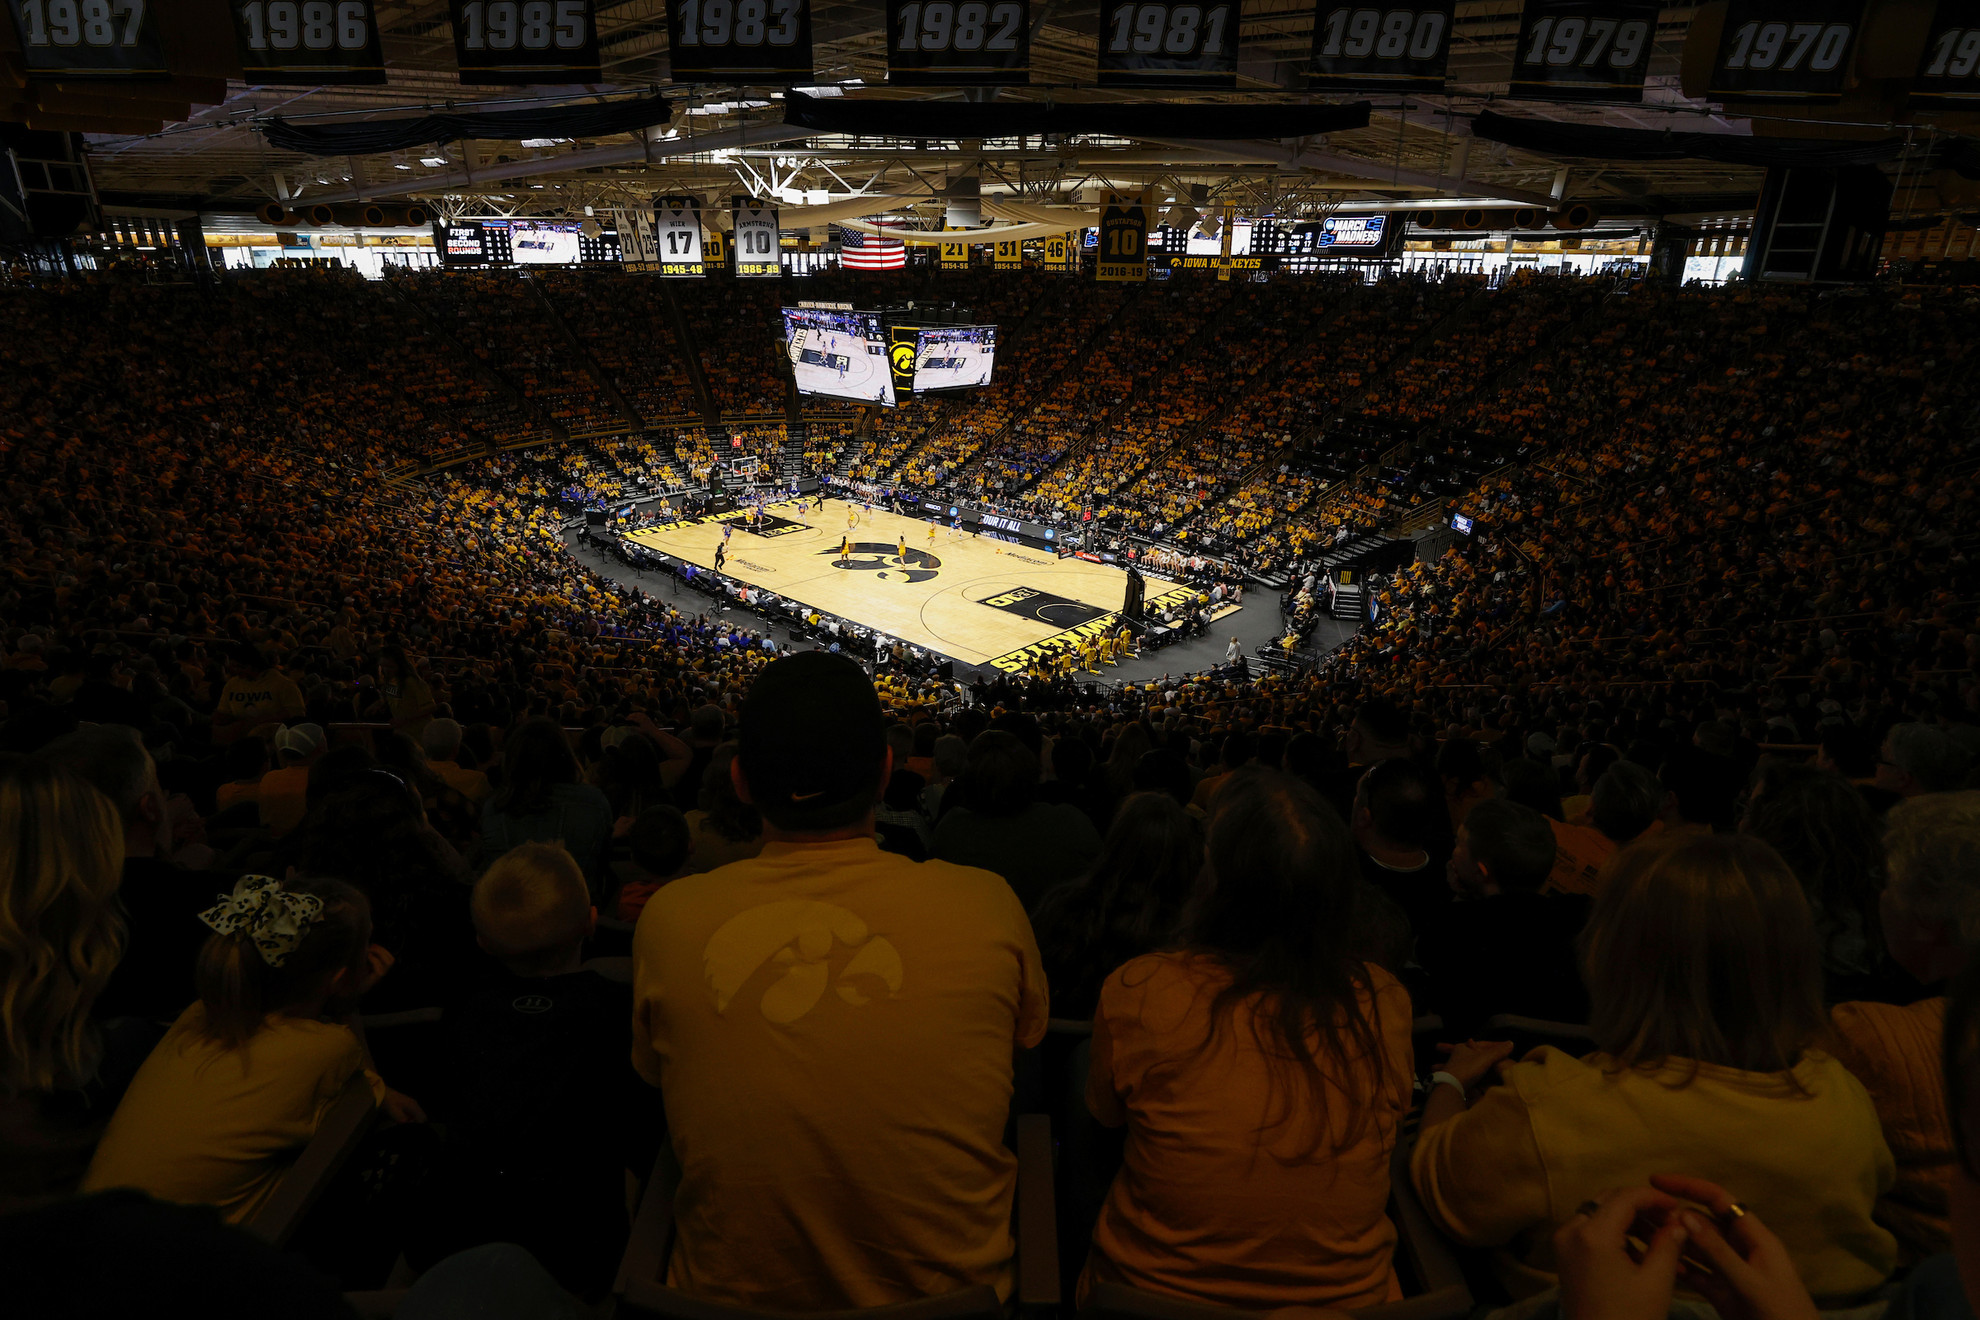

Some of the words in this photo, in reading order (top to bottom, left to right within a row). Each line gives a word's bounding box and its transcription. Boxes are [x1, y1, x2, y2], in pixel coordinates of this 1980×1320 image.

[21, 0, 146, 47] 1987
[241, 0, 368, 51] 1986
[461, 0, 587, 51] 1985
[678, 0, 802, 48] 1983
[897, 1, 1024, 52] 1982
[1108, 3, 1232, 55] 1981
[1320, 7, 1447, 60] 1980
[1523, 16, 1650, 69] 1979
[1723, 20, 1853, 73] 1970
[670, 220, 686, 228] WIER
[739, 220, 775, 230] ARMSTRONG
[1106, 218, 1143, 228] GUSTAFSON
[1334, 219, 1367, 231] MARCH
[449, 228, 475, 237] FIRST
[1336, 230, 1381, 242] MADNESS
[447, 239, 480, 247] SECOND
[621, 233, 634, 254] 27
[642, 234, 654, 254] 23
[667, 231, 692, 255] 17
[743, 230, 771, 254] 10
[946, 242, 968, 256] 21
[999, 240, 1017, 257] 31
[1047, 241, 1063, 257] 46
[1108, 229, 1138, 255] 10
[1455, 241, 1485, 250] IOWA
[447, 247, 482, 255] ROUNDS
[662, 264, 703, 275] 1945-48
[738, 264, 779, 275] 1986-89
[941, 262, 969, 270] 1954-56
[994, 262, 1021, 270] 1954-56
[1044, 263, 1066, 271] 1954-56
[1183, 257, 1208, 268] IOWA
[1101, 266, 1143, 277] 2016-19
[622, 521, 697, 539] IOWA
[998, 517, 1006, 529] IT
[1006, 519, 1022, 532] ALL
[229, 691, 273, 702] IOWA
